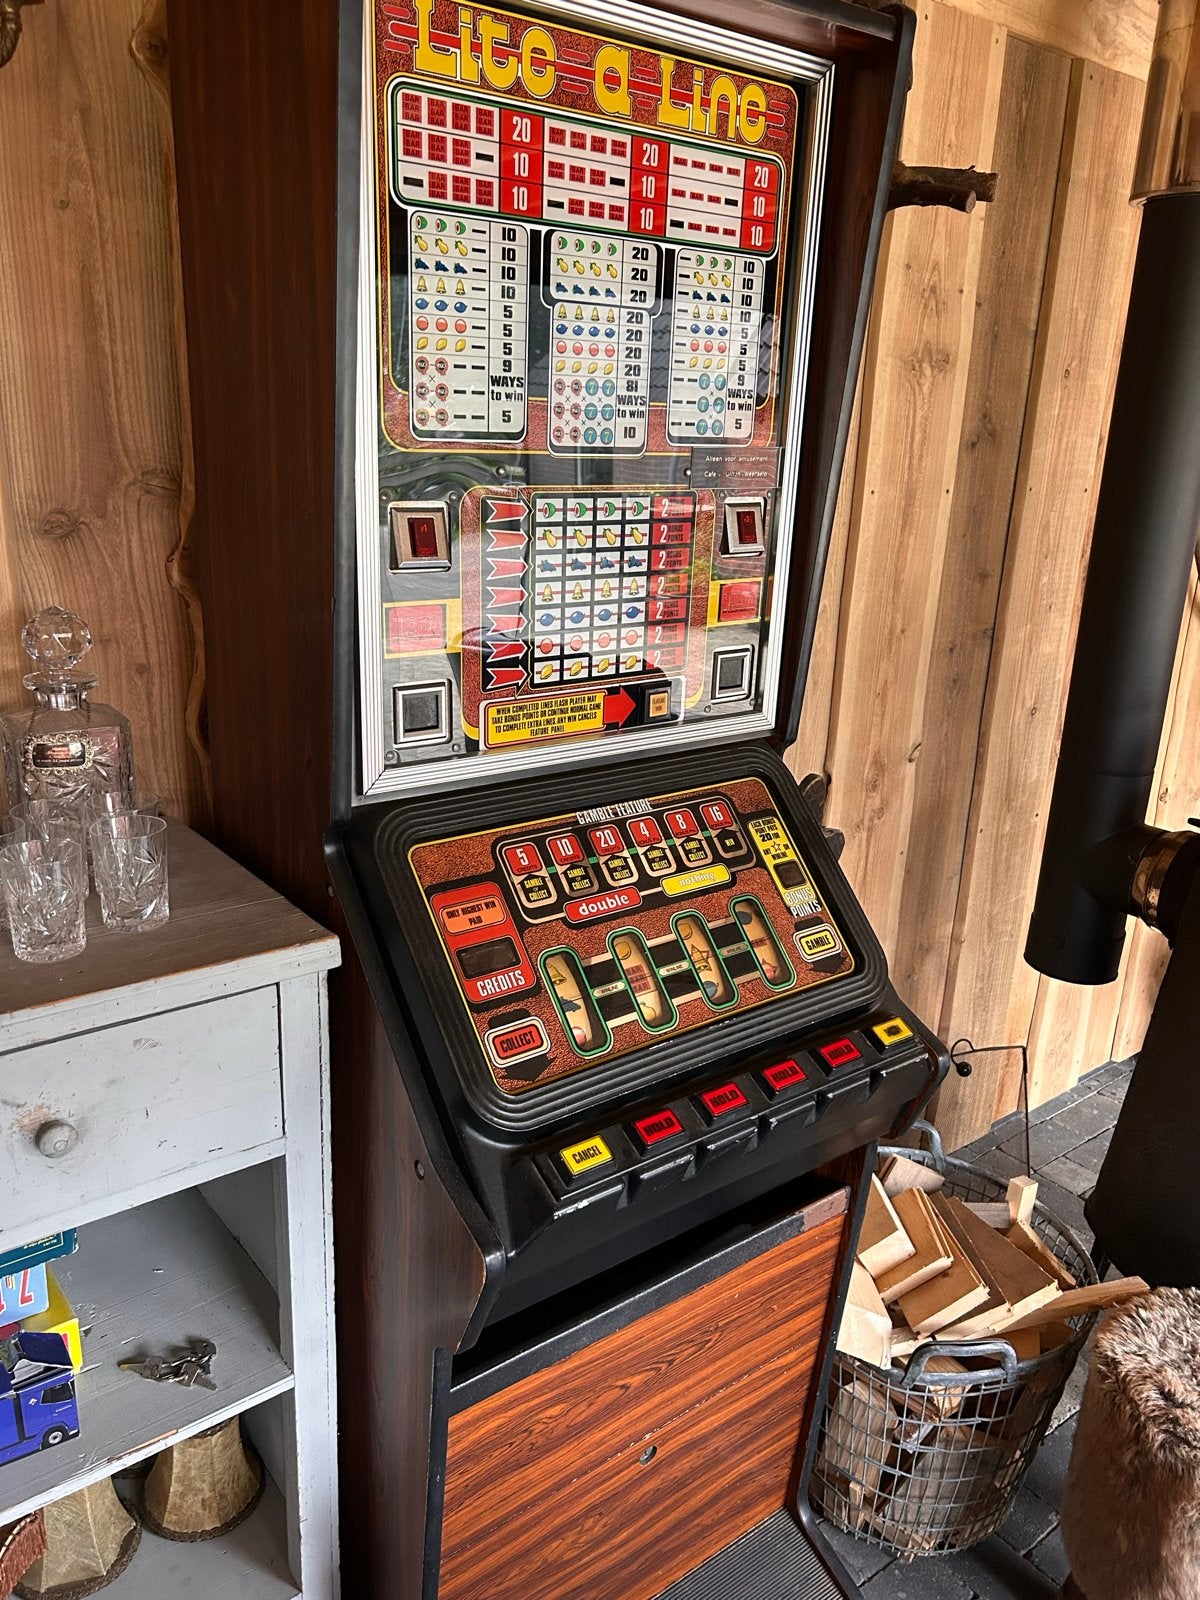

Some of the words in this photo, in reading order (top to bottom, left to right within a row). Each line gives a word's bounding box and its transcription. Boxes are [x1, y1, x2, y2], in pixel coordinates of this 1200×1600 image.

[414, 0, 556, 98] Lite
[594, 44, 631, 118] a
[657, 55, 767, 144] Line
[512, 116, 531, 143] 20
[642, 143, 658, 167] 20
[513, 152, 529, 178] 10
[754, 166, 769, 188] 20
[642, 176, 655, 198] 10
[512, 186, 528, 211] 10
[753, 196, 765, 218] 10
[640, 208, 653, 230] 10
[502, 227, 516, 242] 10
[751, 226, 763, 247] 10
[502, 247, 516, 262] 10
[632, 246, 648, 260] 20
[501, 266, 516, 281] 10
[631, 267, 648, 282] 20
[743, 260, 755, 274] 10
[742, 278, 753, 290] 10
[501, 285, 515, 300] 10
[630, 289, 647, 303] 20
[741, 294, 752, 307] 10
[504, 305, 513, 319] 5
[627, 311, 643, 325] 20
[740, 311, 751, 323] 10
[503, 324, 513, 337] 5
[626, 329, 642, 342] 20
[741, 327, 748, 339] 5
[503, 342, 512, 356] 5
[625, 347, 641, 359] 20
[740, 344, 747, 355] 5
[503, 359, 512, 373] 9
[624, 364, 641, 377] 20
[739, 360, 746, 371] 5
[490, 375, 524, 388] WAYS
[738, 375, 745, 386] 9
[491, 389, 502, 401] to
[505, 390, 523, 402] win
[617, 394, 646, 406] WAYS
[728, 388, 753, 399] WAYS
[727, 400, 736, 410] to
[738, 401, 752, 411] win
[502, 410, 512, 423] 5
[617, 408, 627, 418] to
[629, 408, 645, 419] win
[735, 418, 742, 430] 5
[624, 426, 636, 439] 10
[661, 499, 669, 517] 2
[660, 525, 668, 543] 2
[659, 551, 666, 568] 2
[657, 577, 665, 594] 2
[656, 602, 663, 619] 2
[655, 626, 662, 643] 2
[654, 650, 660, 667] 2
[496, 706, 511, 715] WHEN
[512, 702, 539, 713] COMPLETED
[540, 700, 553, 710] LINES
[554, 698, 569, 707] FLASH
[570, 696, 586, 705] PLAYER
[587, 695, 597, 703] MAY
[492, 716, 503, 724] TAKE
[504, 714, 521, 723] BONUS
[522, 711, 539, 720] POINTS
[540, 709, 547, 718] OR
[548, 707, 570, 717] CONTINUE
[570, 704, 588, 713] NORMAL
[589, 702, 602, 711] GAME
[496, 725, 502, 733] TO
[503, 722, 527, 732] COMPLETE
[527, 720, 542, 728] EXTRA
[556, 716, 567, 724] ANY
[567, 714, 577, 722] WIN
[577, 712, 597, 721] CANCELS
[530, 727, 549, 737] FEATURE
[576, 806, 615, 824] GAMBLE
[615, 798, 652, 816] FEATURE
[709, 806, 723, 821] 16
[639, 821, 650, 837] 4
[675, 814, 687, 829] 8
[596, 829, 616, 847] 20
[759, 833, 772, 842] 20
[556, 838, 574, 857] 10
[516, 848, 529, 866] 5
[613, 869, 631, 880] COLLECT
[680, 872, 715, 886] nothing
[572, 879, 591, 890] COLLECT
[529, 890, 548, 901] COLLECT
[785, 887, 814, 905] BONUS
[446, 909, 460, 919] ONLY
[462, 903, 484, 916] HIGHEST
[485, 900, 496, 910] WIN
[578, 894, 630, 916] double
[790, 900, 821, 918] POINTS
[469, 916, 483, 926] PAID
[805, 935, 831, 950] GAMBLE
[476, 970, 525, 997] CREDITS
[500, 1030, 535, 1052] COLLECT
[828, 1043, 854, 1060] HOLD
[772, 1065, 798, 1081] HOLD
[710, 1089, 739, 1107] HOLD
[644, 1117, 674, 1136] HOLD
[572, 1144, 602, 1164] CANCEL
